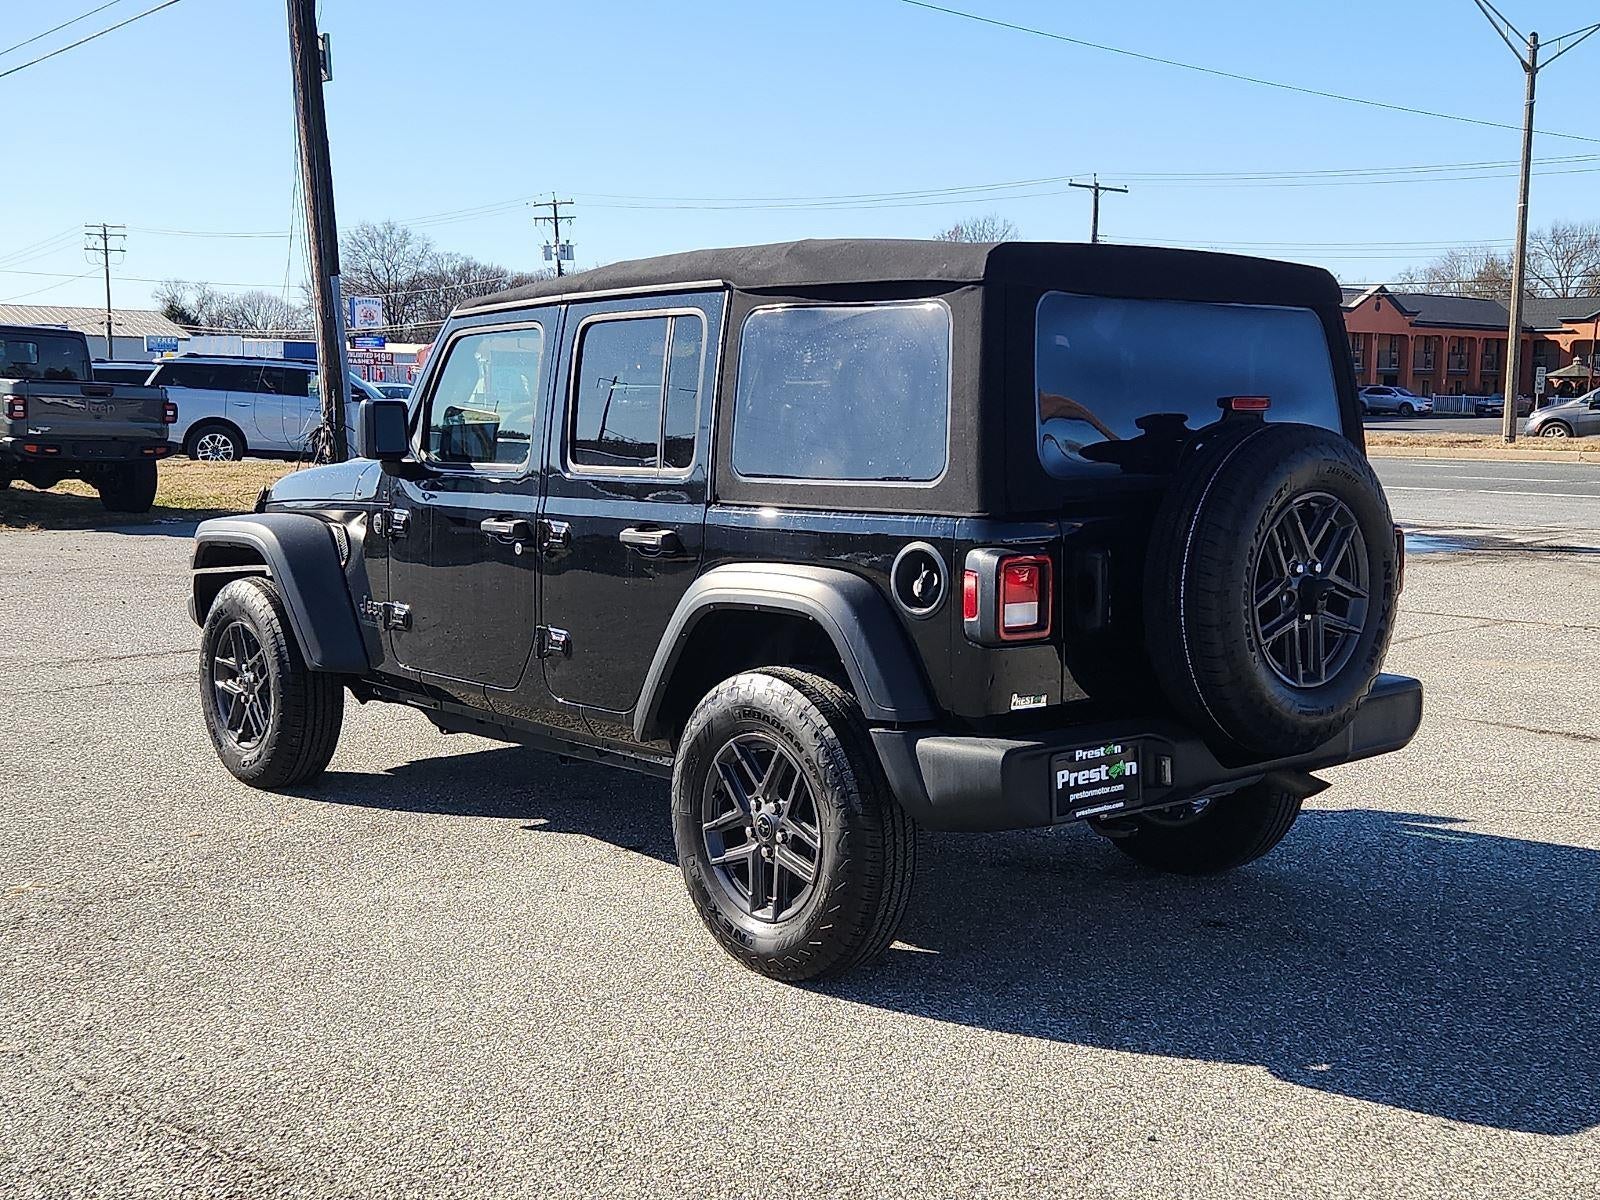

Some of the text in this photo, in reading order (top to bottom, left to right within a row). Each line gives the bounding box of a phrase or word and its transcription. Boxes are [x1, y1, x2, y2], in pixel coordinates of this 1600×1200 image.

[79, 400, 116, 415] Jeep
[1075, 744, 1121, 761] Preston
[1056, 759, 1137, 790] Preston
[1069, 783, 1125, 803] prestonmotor.com
[1075, 801, 1124, 818] prestonmotor.com
